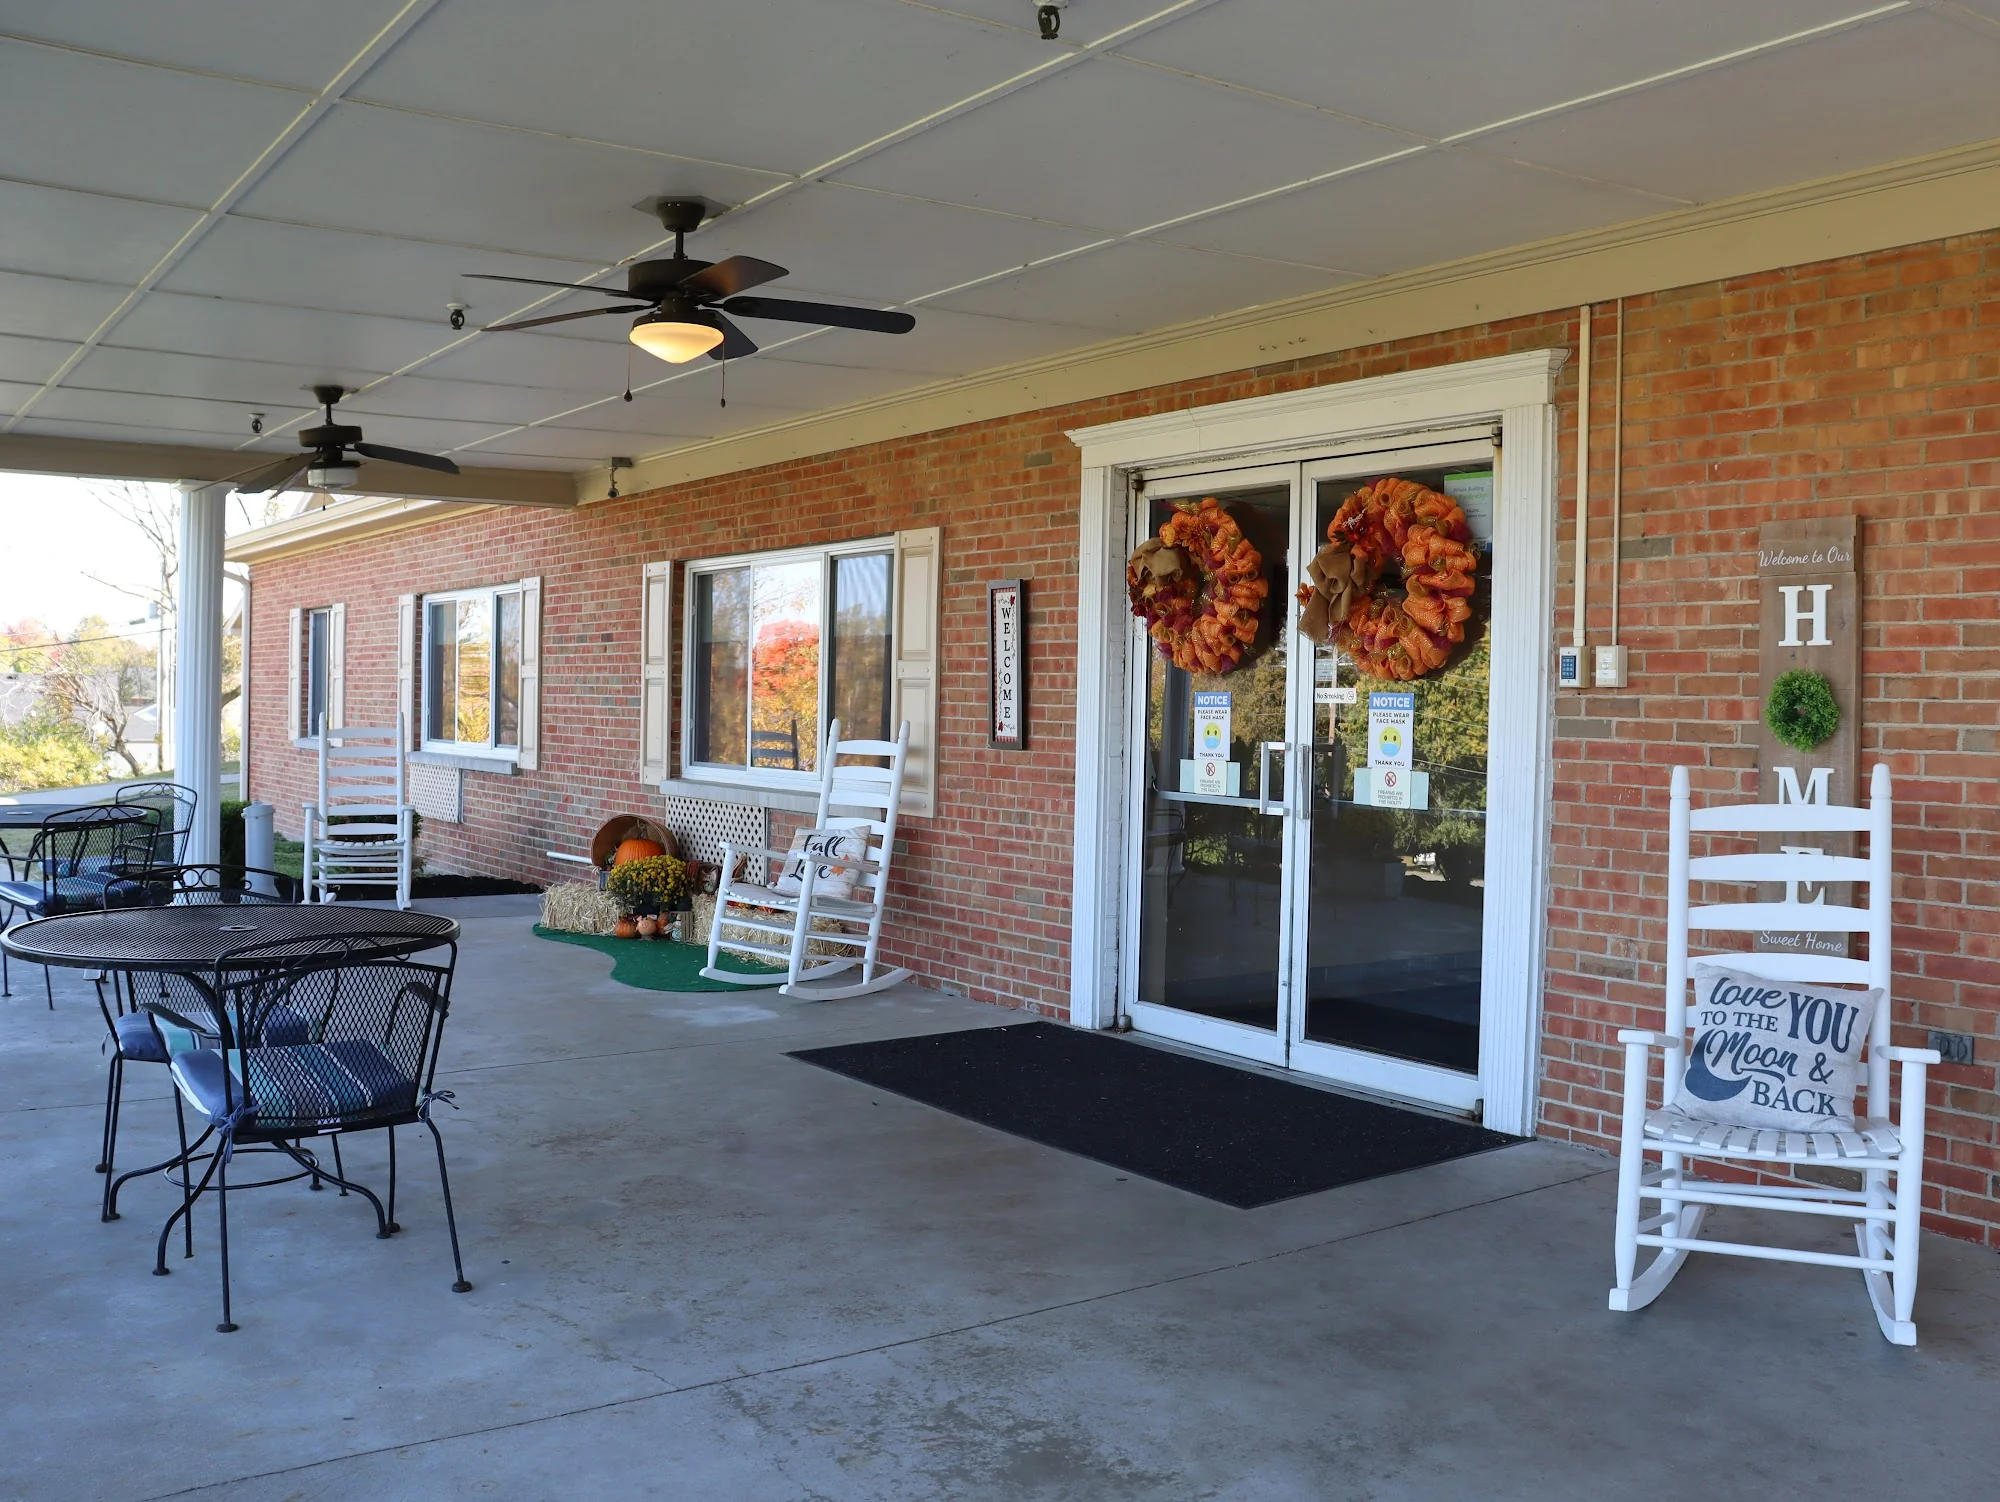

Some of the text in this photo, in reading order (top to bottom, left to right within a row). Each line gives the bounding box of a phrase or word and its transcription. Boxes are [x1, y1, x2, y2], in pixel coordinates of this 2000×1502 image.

[1758, 545, 1853, 567] Welcome to Our
[1002, 607, 1012, 719] WELCOME
[1197, 695, 1228, 705] NOTICE
[1324, 692, 1345, 701] Smoking
[1372, 696, 1411, 708] NOTICE
[802, 834, 846, 857] Fall
[1760, 930, 1844, 952] Sweet Home
[1700, 1010, 1778, 1032] TO THE
[1787, 991, 1860, 1054] YOU
[1705, 1028, 1834, 1084] Moon &
[1750, 1080, 1838, 1116] BACK
